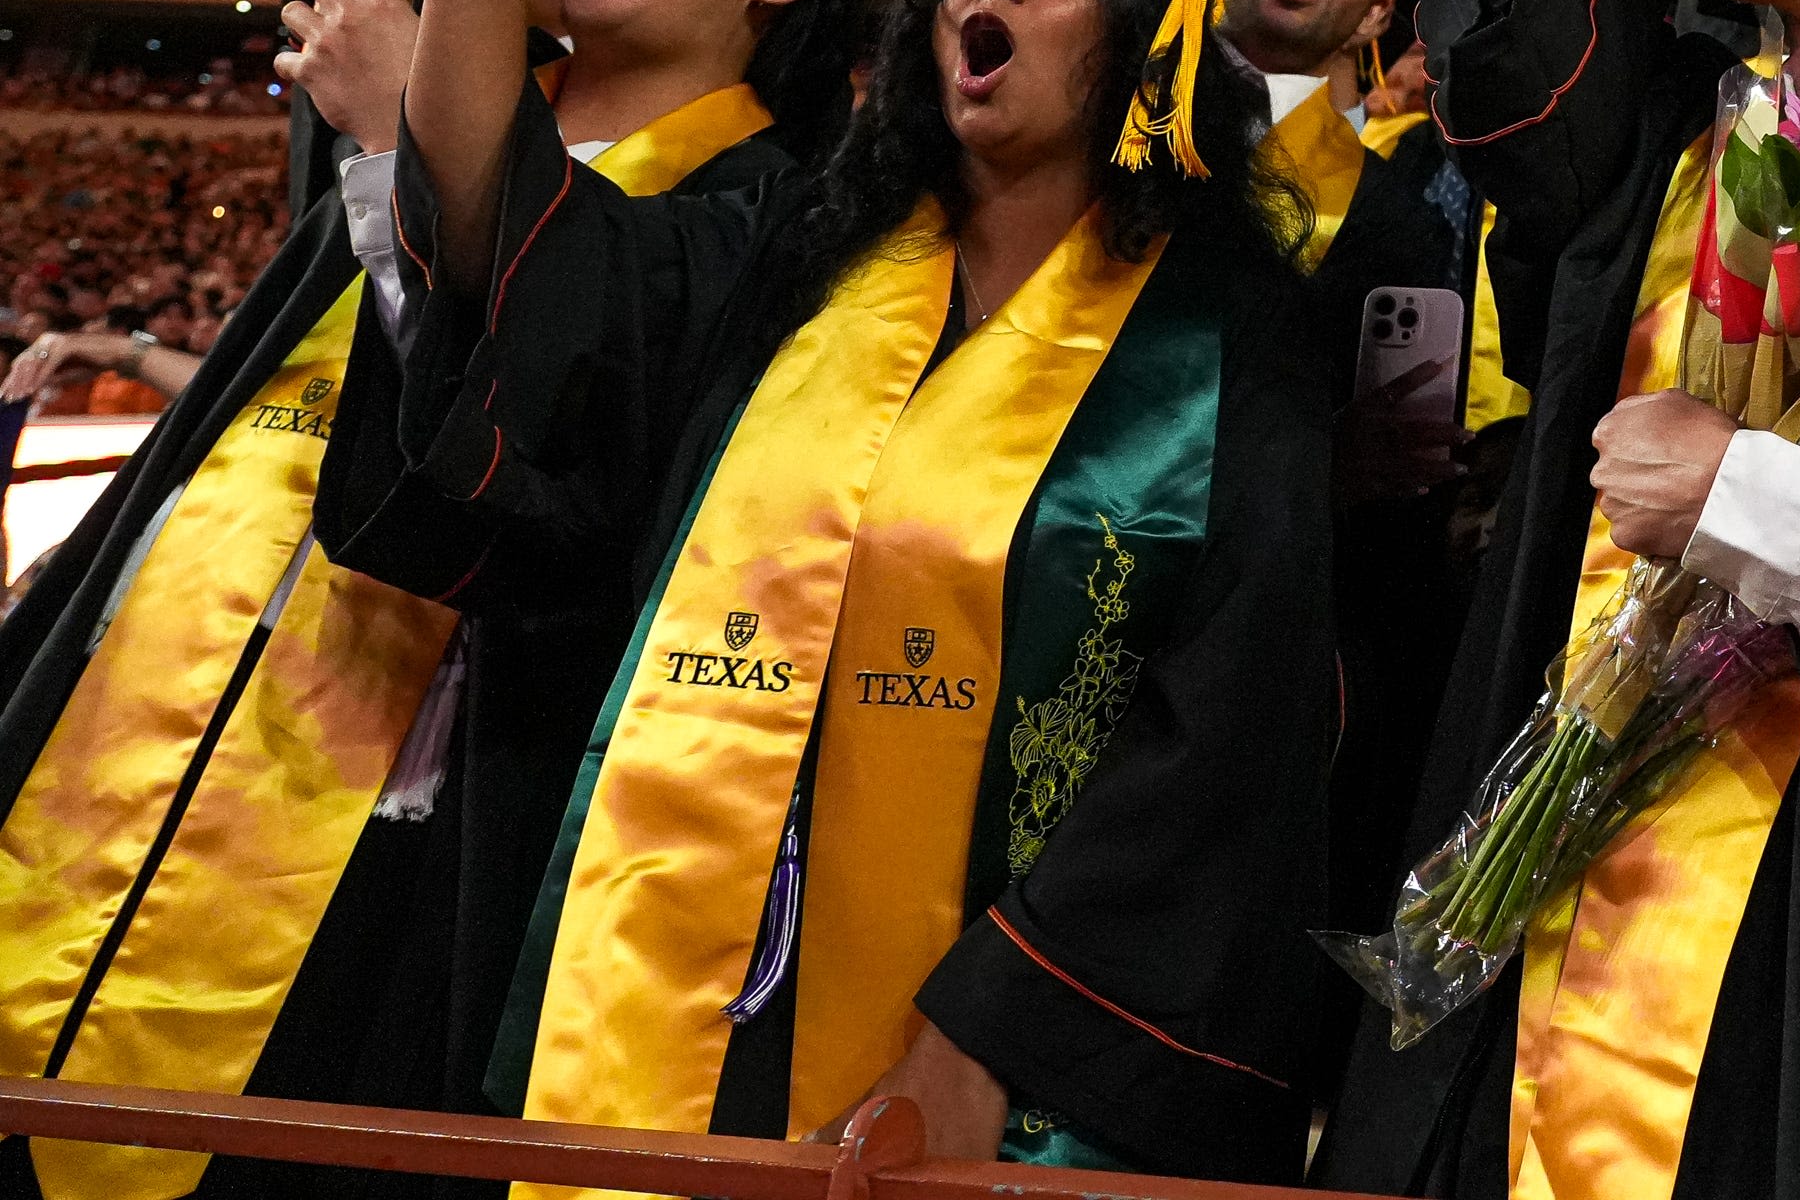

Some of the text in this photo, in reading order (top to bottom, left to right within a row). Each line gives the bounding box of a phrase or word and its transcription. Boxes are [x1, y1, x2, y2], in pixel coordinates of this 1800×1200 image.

[250, 405, 330, 440] TEXA
[666, 652, 793, 692] TEXAS
[856, 672, 977, 710] TEXAS
